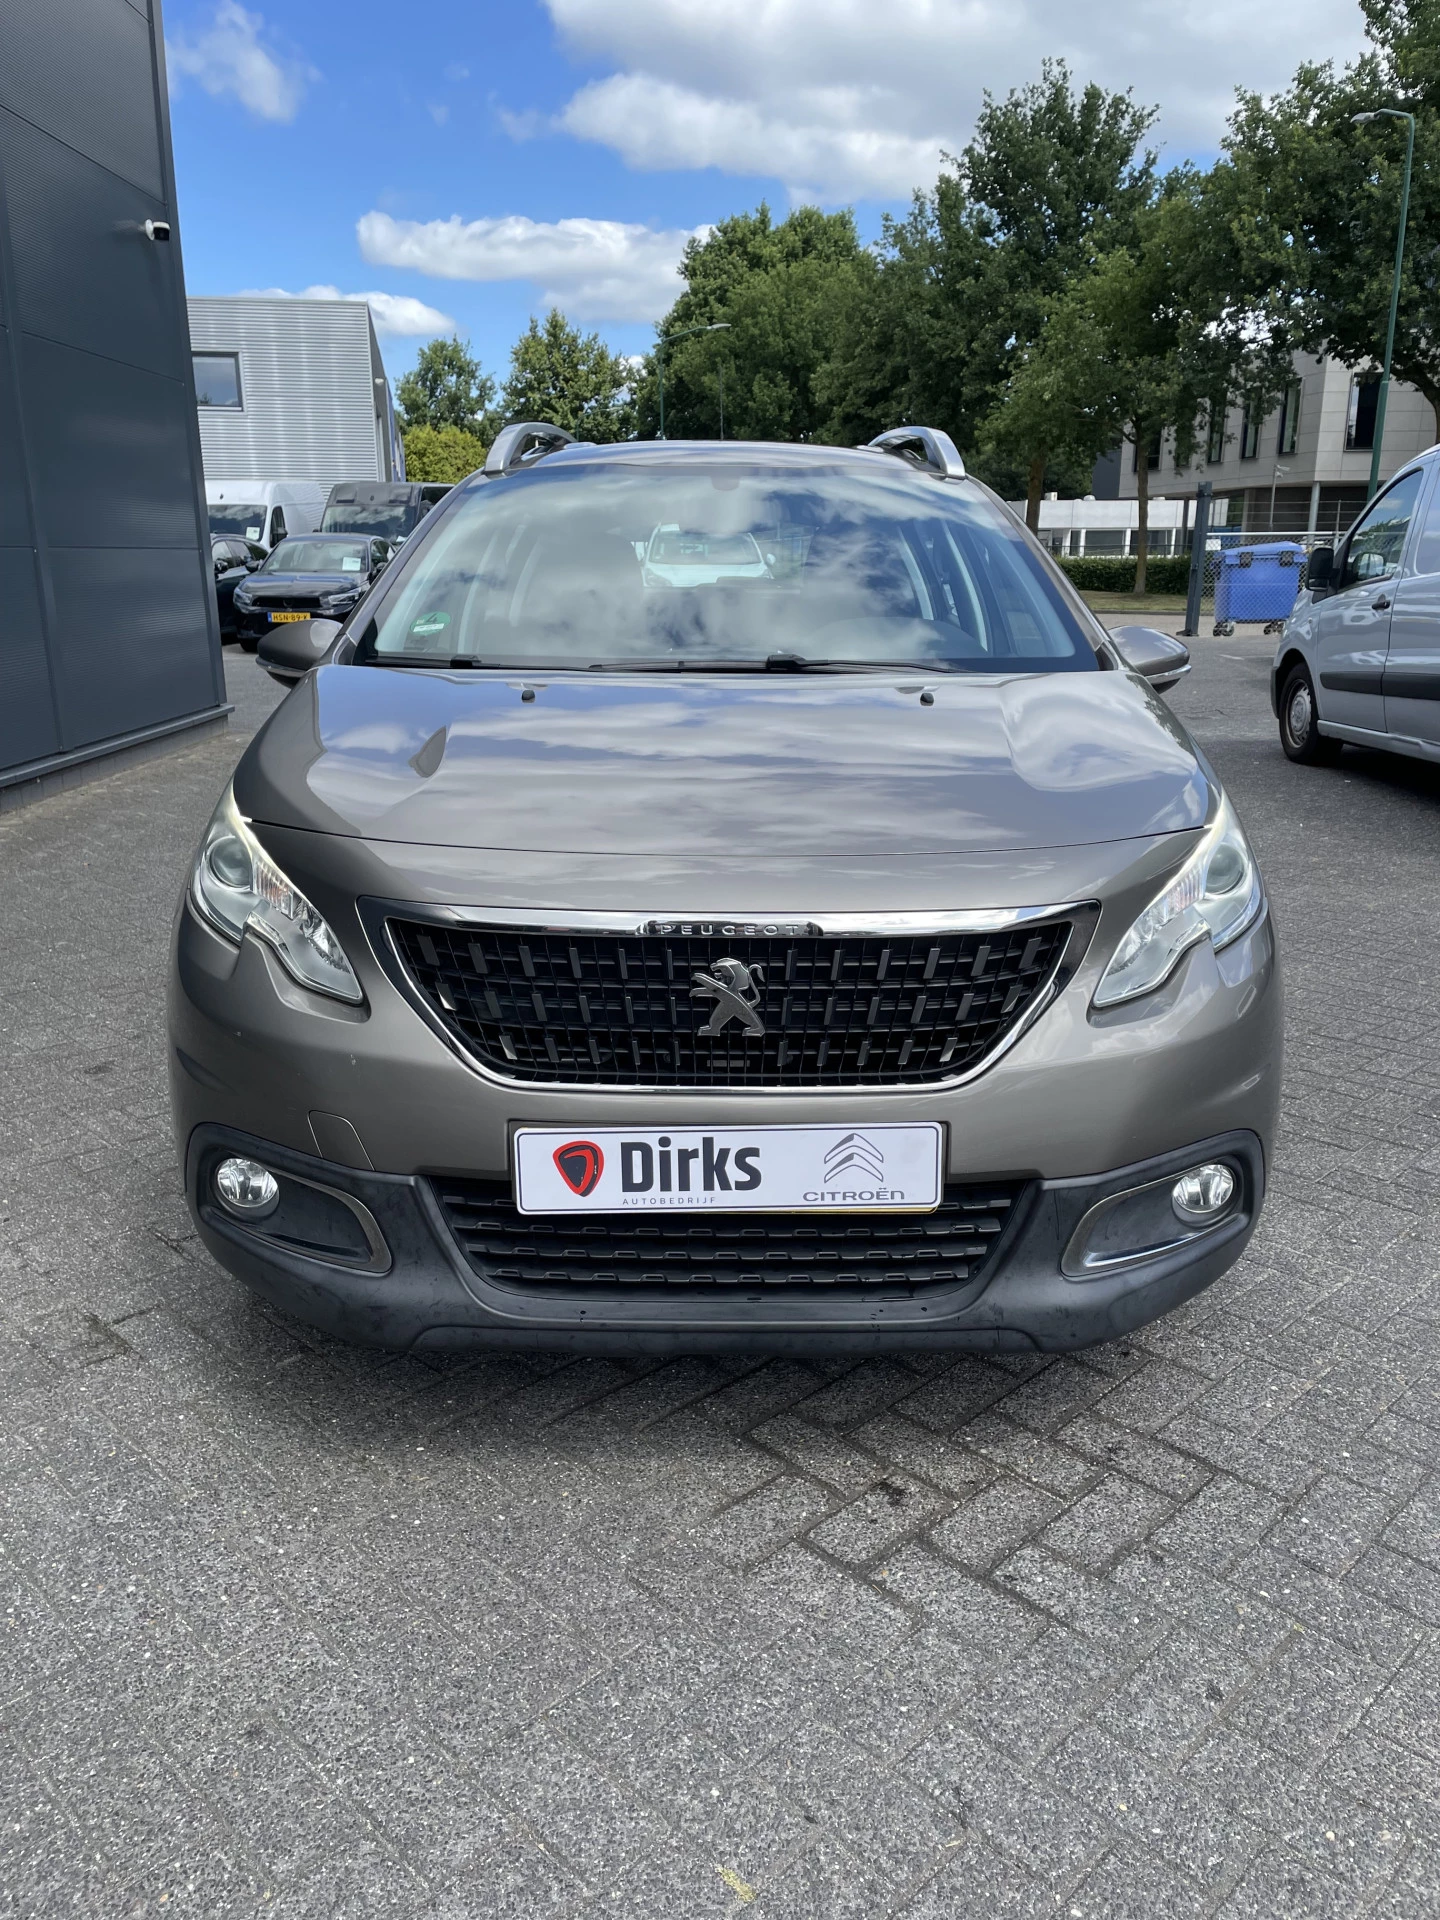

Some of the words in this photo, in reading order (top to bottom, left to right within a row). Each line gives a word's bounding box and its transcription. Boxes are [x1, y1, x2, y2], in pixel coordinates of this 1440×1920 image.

[660, 924, 799, 936] PEUGEOT
[620, 1136, 762, 1193] Dirks
[622, 1196, 717, 1206] AUTOBEDRIJF
